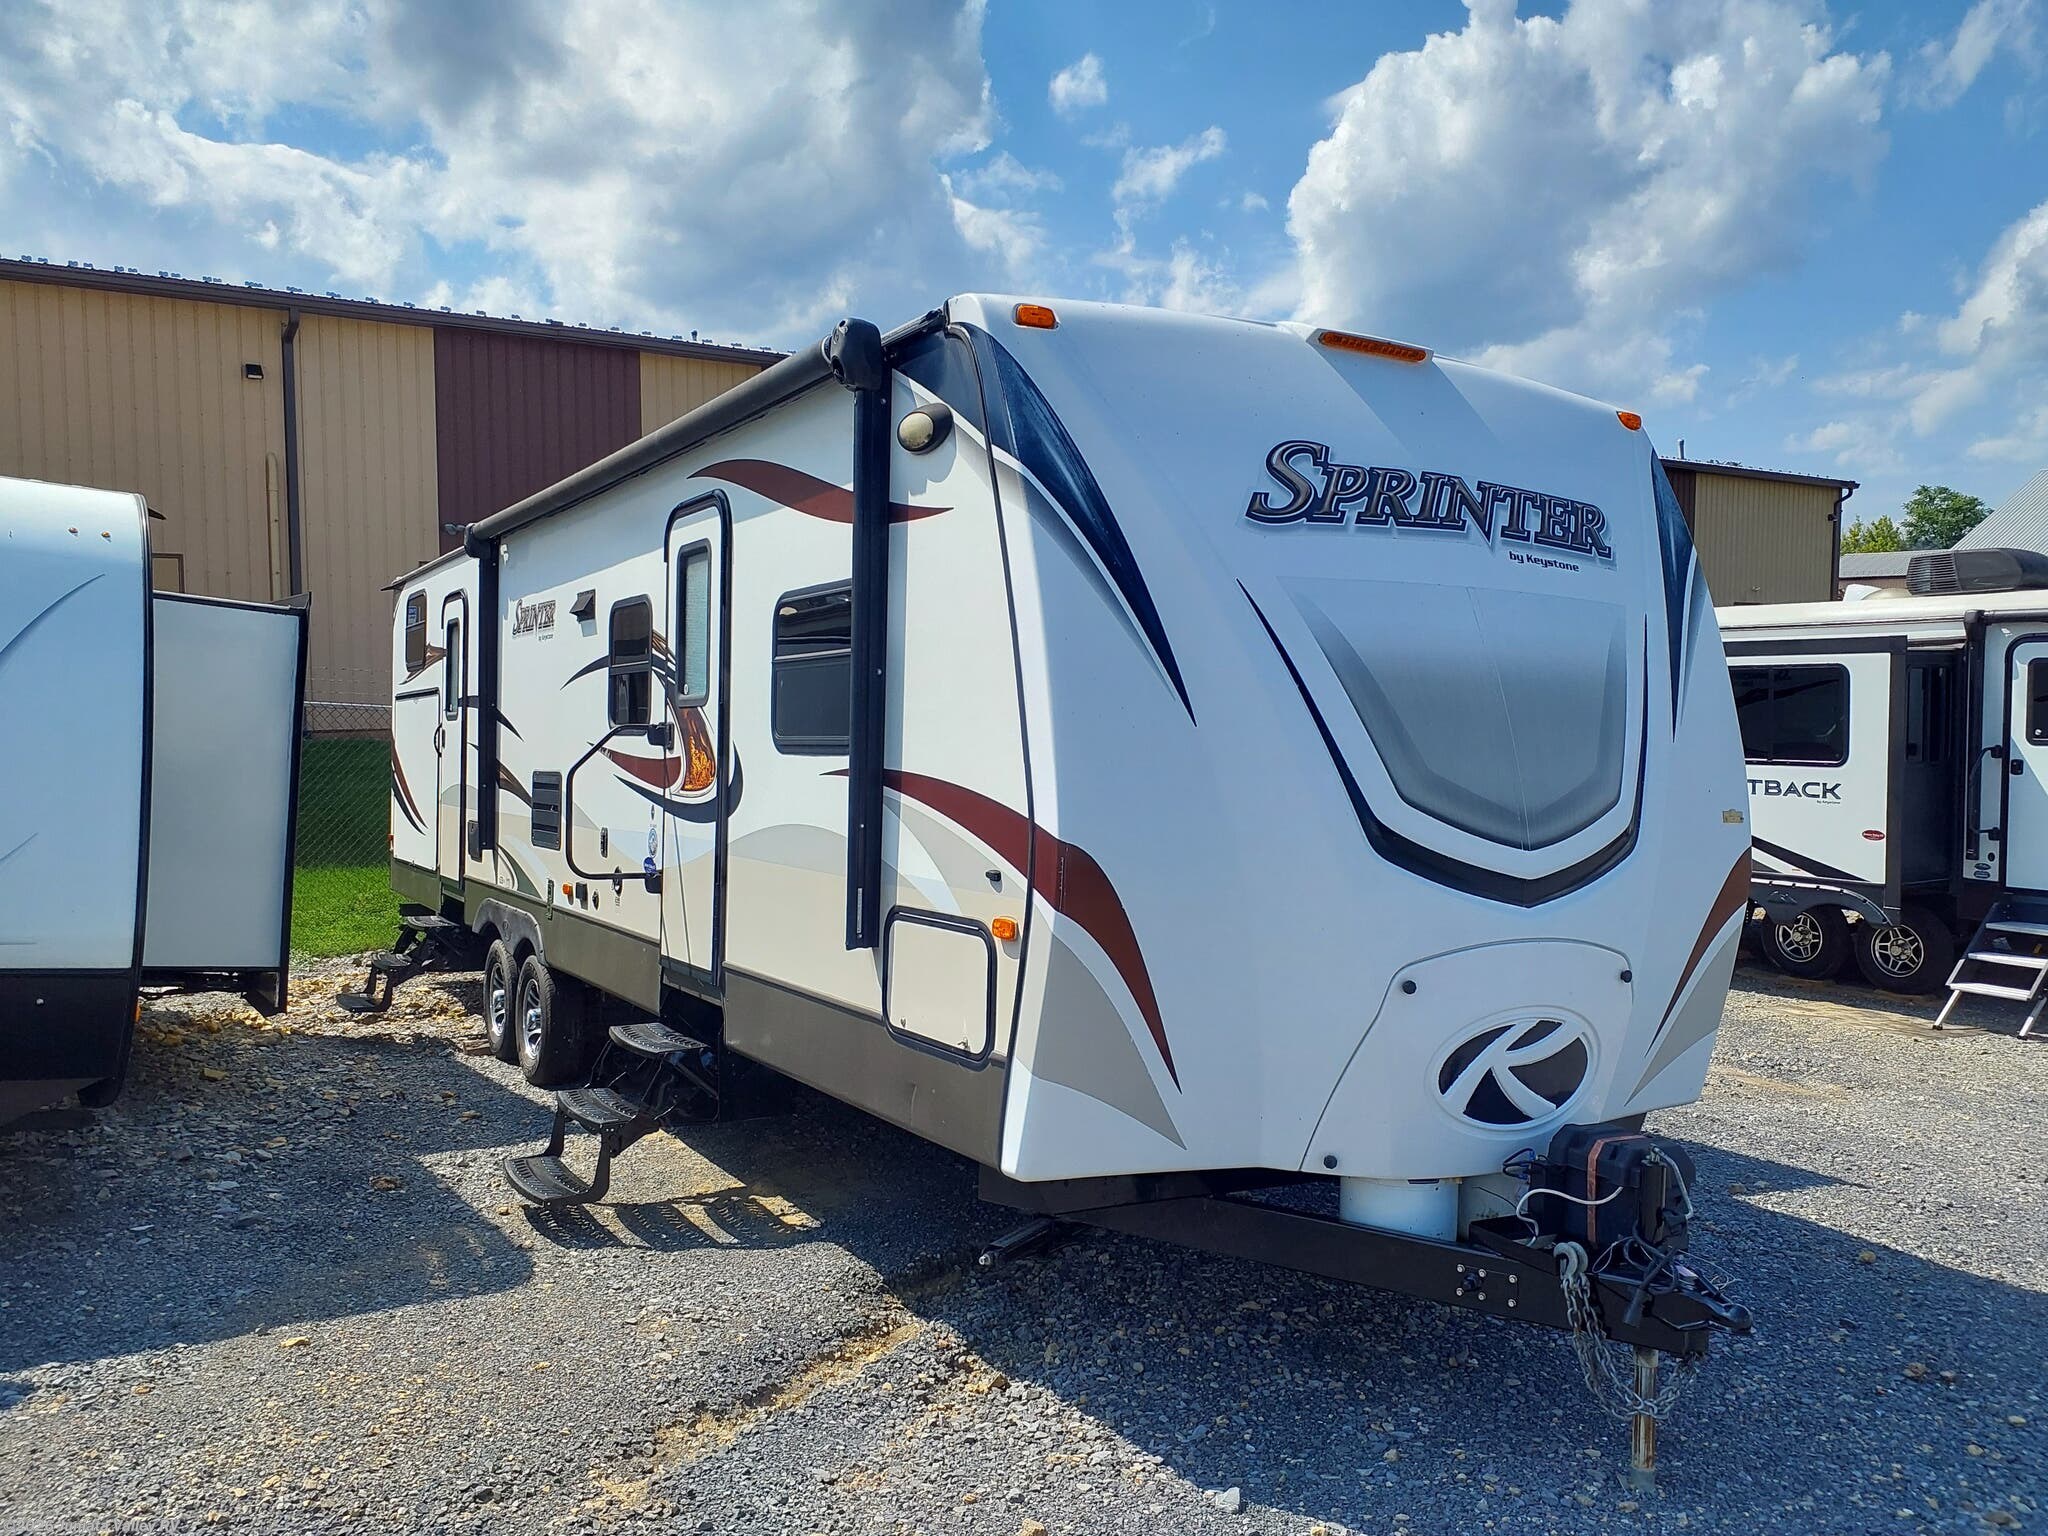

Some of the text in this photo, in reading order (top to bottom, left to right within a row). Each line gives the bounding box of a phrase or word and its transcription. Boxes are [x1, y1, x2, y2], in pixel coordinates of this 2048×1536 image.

[1245, 439, 1613, 558] SPRINTER
[1508, 550, 1580, 572] by Keystone
[1747, 778, 1842, 800] TBACK
